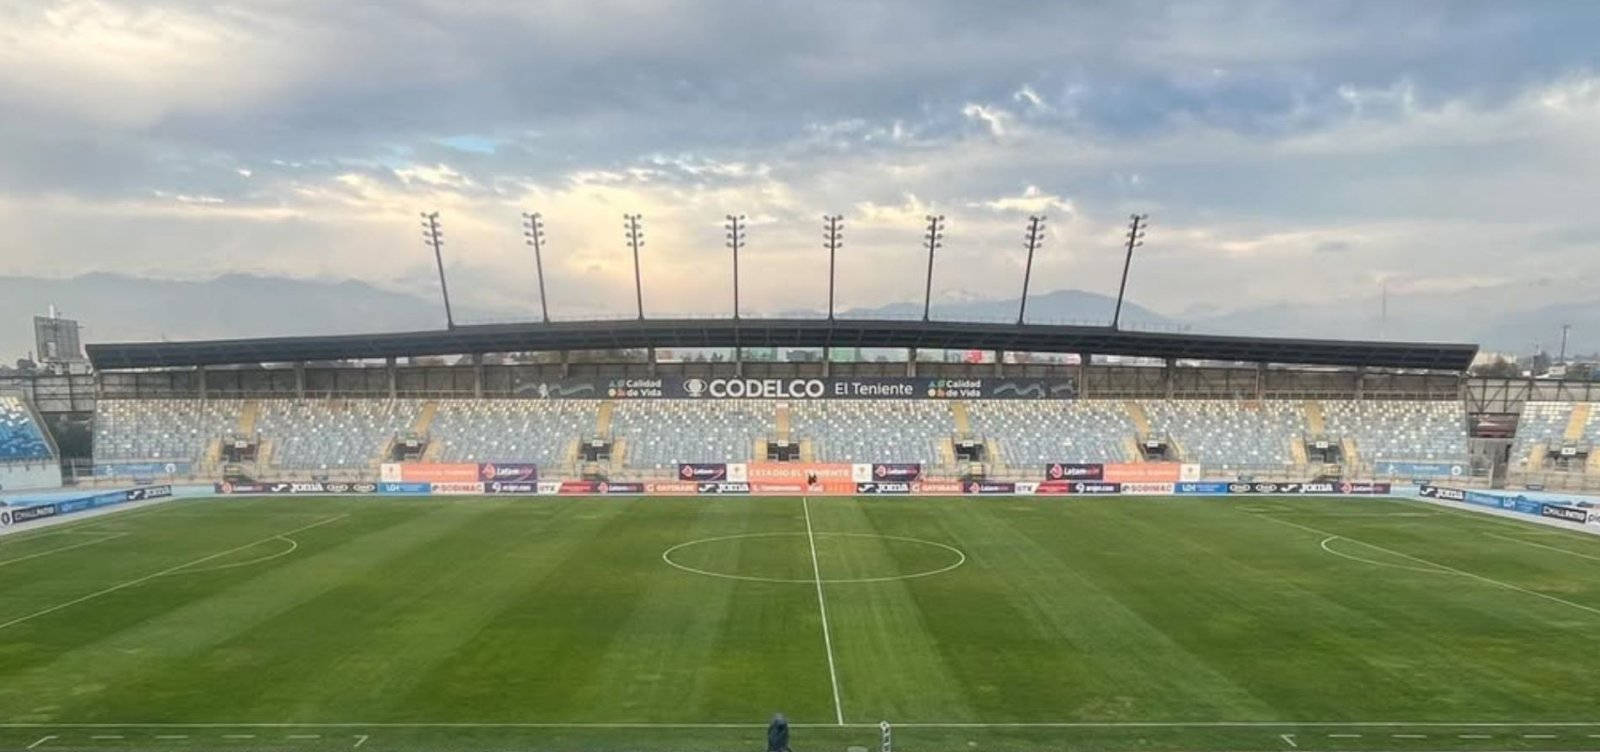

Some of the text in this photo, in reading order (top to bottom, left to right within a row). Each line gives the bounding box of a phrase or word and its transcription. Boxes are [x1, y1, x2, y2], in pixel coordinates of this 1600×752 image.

[626, 379, 661, 388] Calidad
[709, 379, 825, 397] CODELCO
[946, 380, 981, 388] Calidad
[626, 388, 662, 397] de Vida
[834, 382, 914, 395] El Teniente
[946, 388, 981, 397] de Vida
